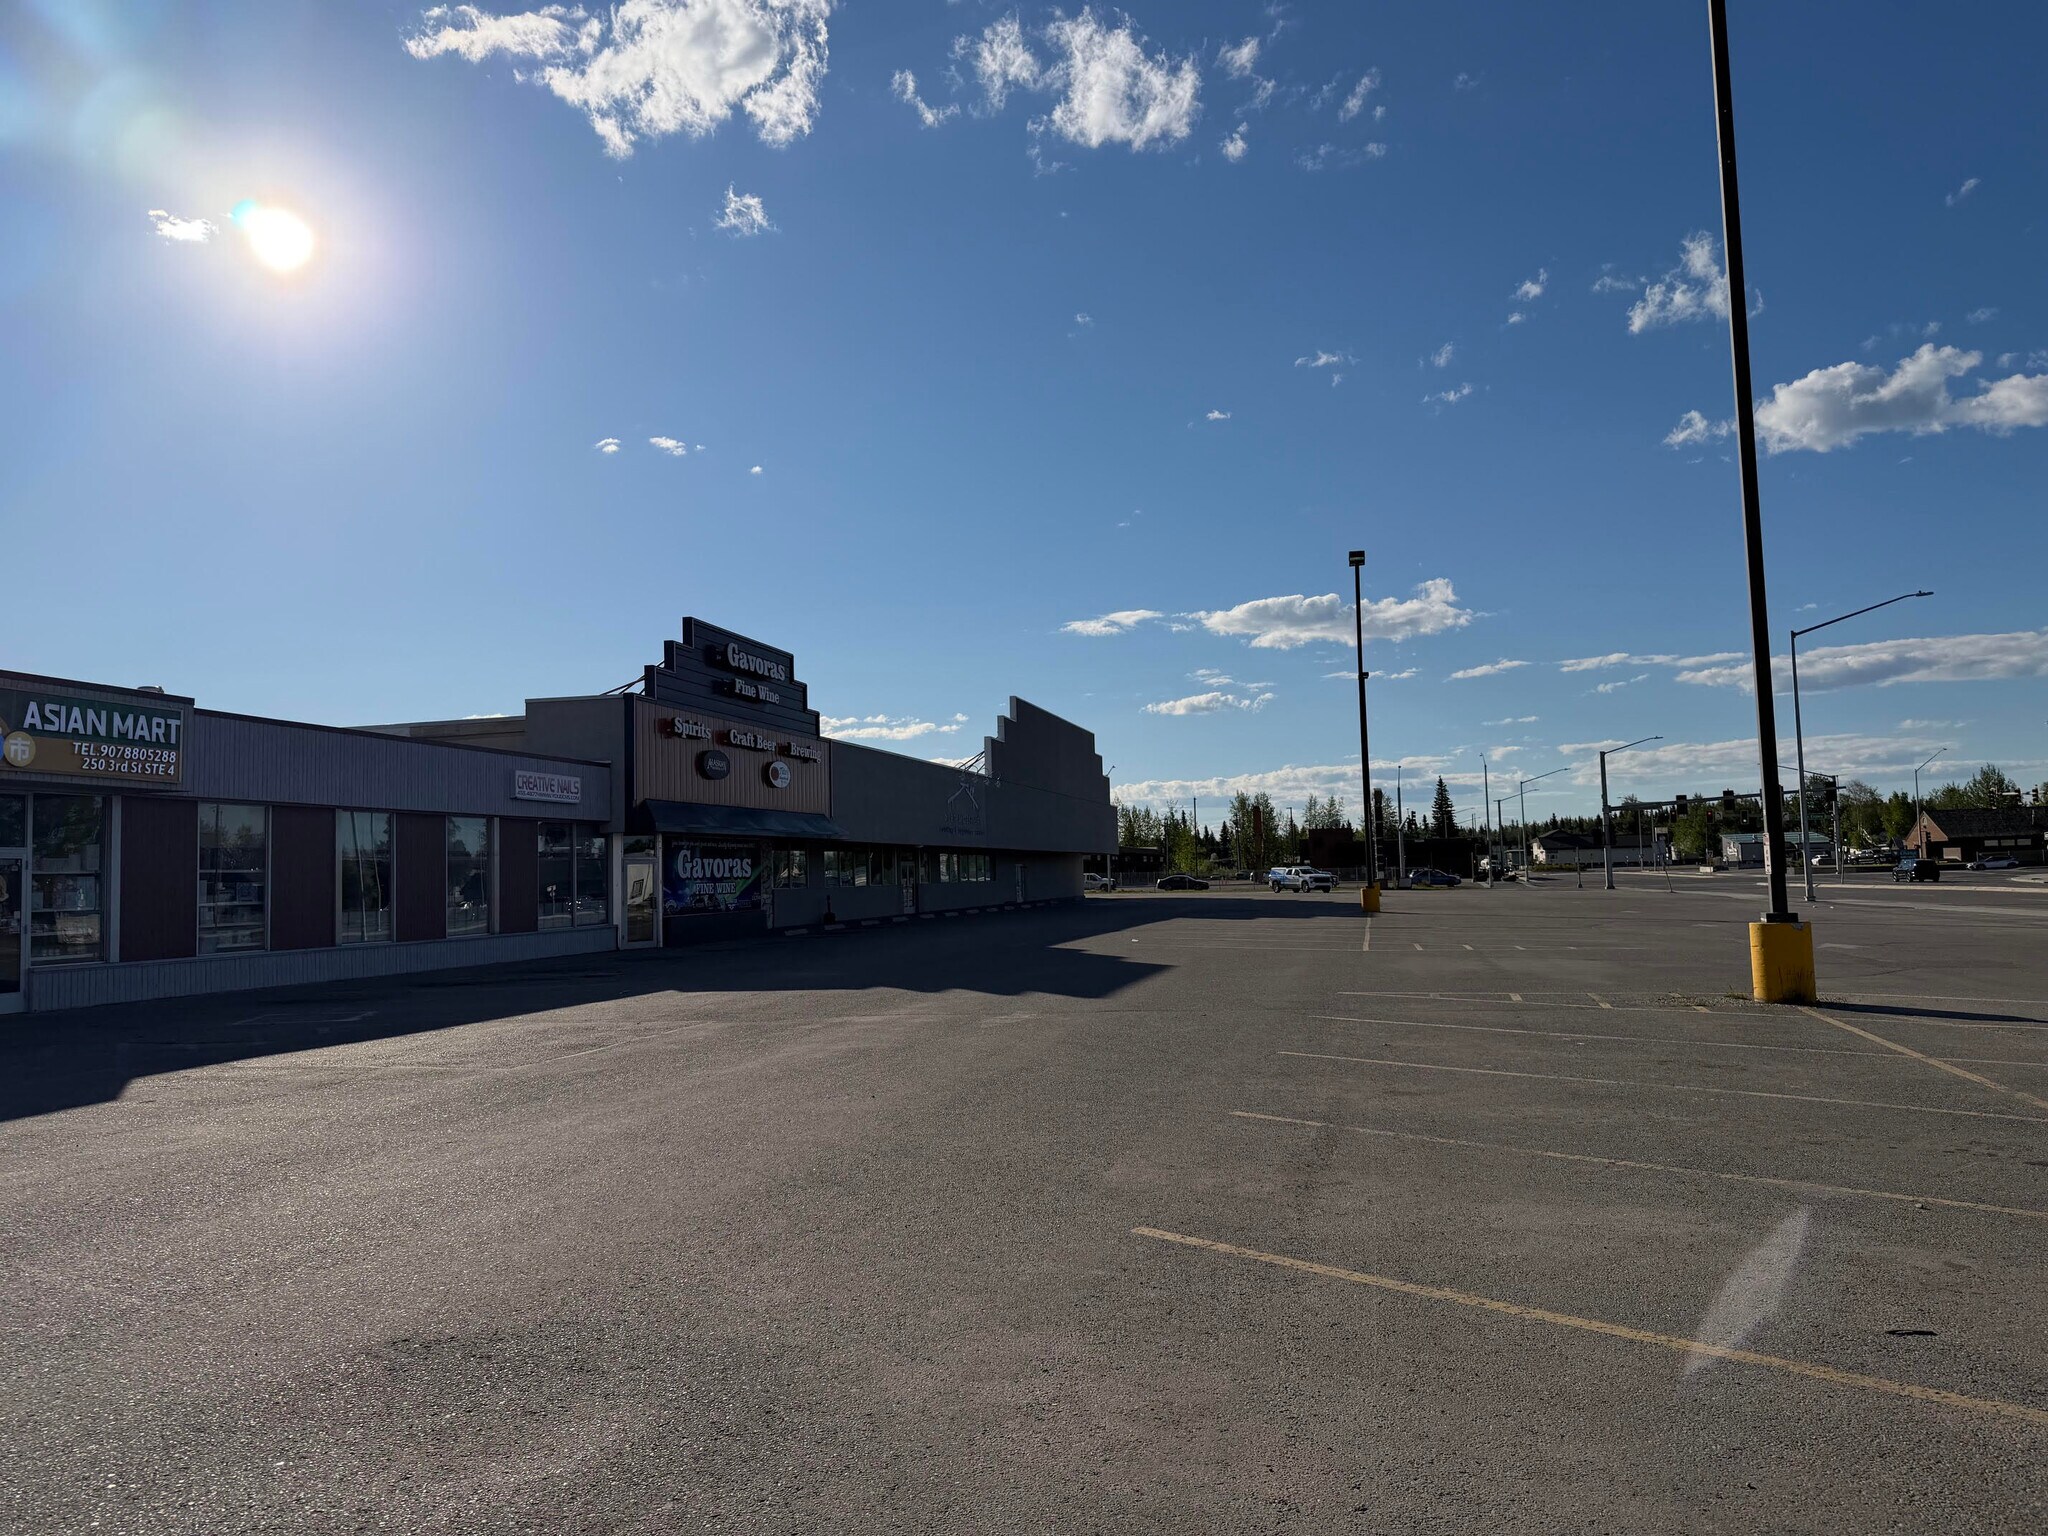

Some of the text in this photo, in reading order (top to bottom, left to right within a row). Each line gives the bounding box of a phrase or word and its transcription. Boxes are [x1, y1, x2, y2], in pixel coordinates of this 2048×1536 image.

[727, 642, 785, 681] Gavoras
[734, 678, 780, 704] Fine Wine
[23, 701, 181, 744] ASIAN MART
[673, 717, 712, 740] Spirits
[730, 729, 776, 751] Craft Beer
[72, 742, 176, 763] TEL.9078805288
[790, 742, 822, 763] Brewing
[82, 758, 175, 776] 250 3rd St STE 4
[517, 775, 580, 795] CREATIVE NAILS
[677, 849, 752, 880] Gavoras
[695, 882, 736, 894] FINE WINE
